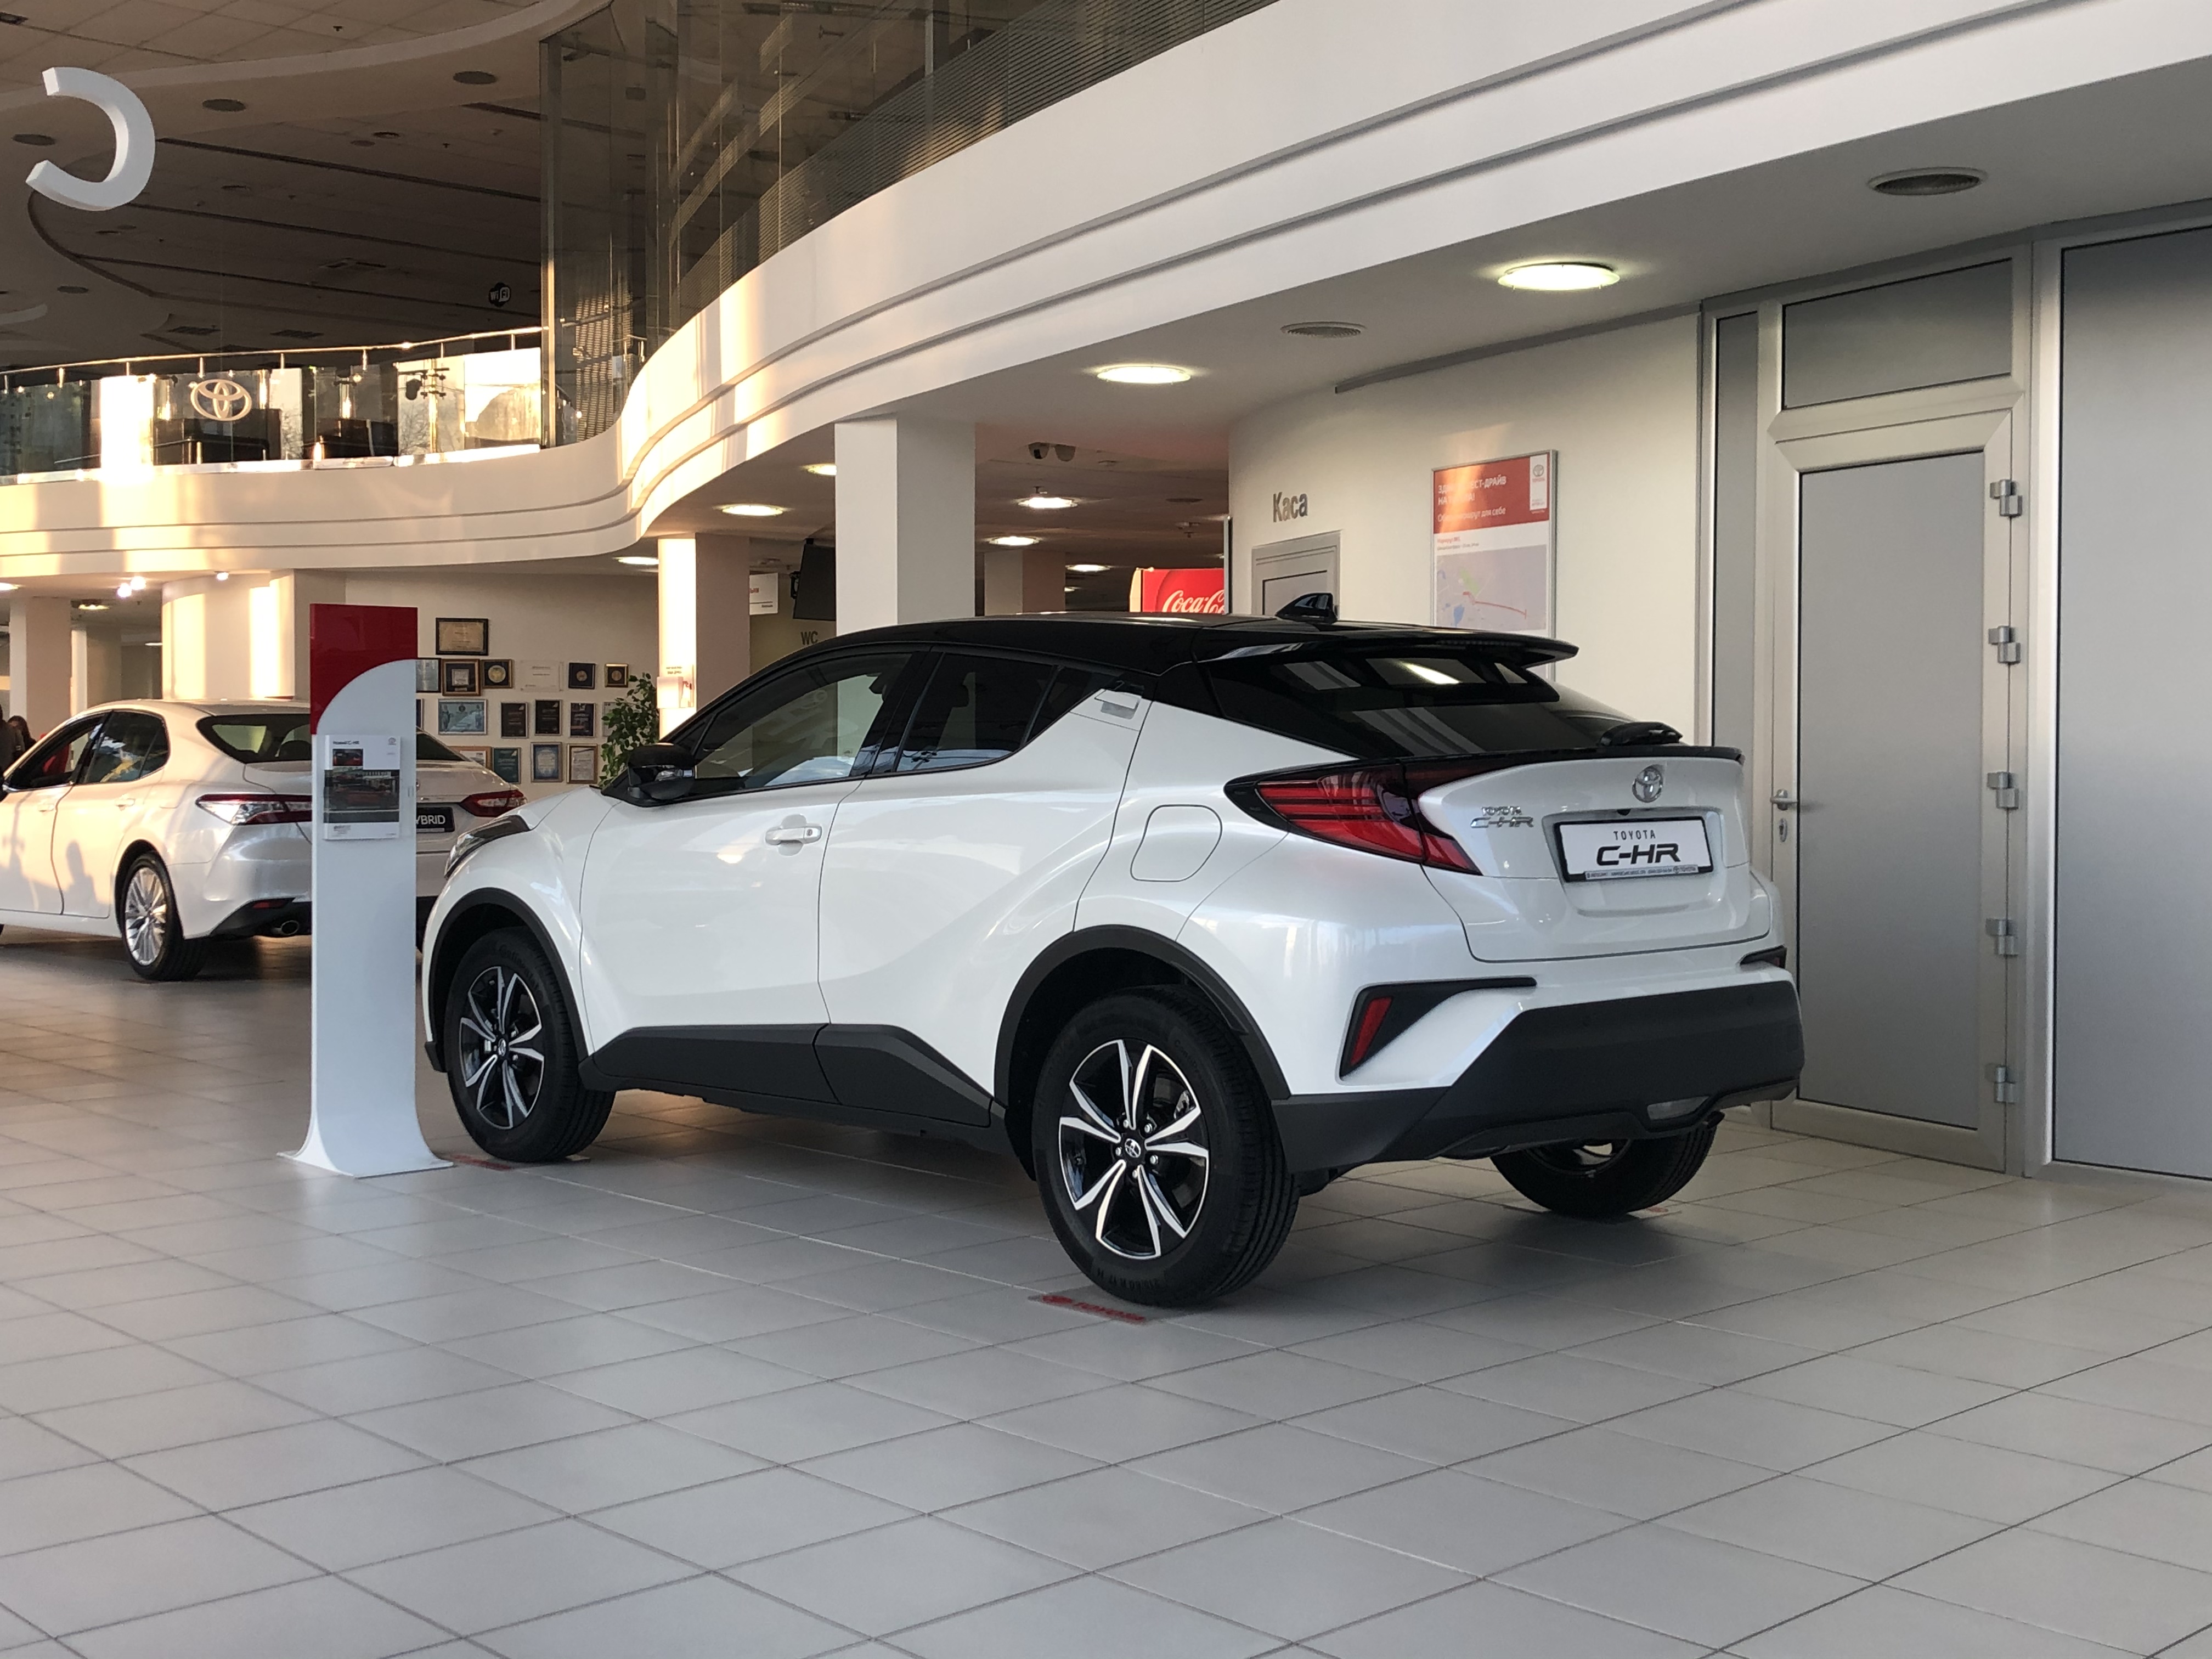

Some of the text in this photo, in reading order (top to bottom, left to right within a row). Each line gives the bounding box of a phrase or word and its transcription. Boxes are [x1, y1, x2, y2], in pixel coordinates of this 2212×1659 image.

[1468, 474, 1506, 489] ЕСТ-ДРАЙВ
[1273, 492, 1308, 523] Каса
[1162, 589, 1224, 613] Coca-Co
[800, 630, 819, 645] WC
[416, 815, 446, 825] YBRID
[1470, 816, 1534, 828] C-HR
[1613, 830, 1656, 840] TOYOTA
[1596, 843, 1681, 866] C-HR
